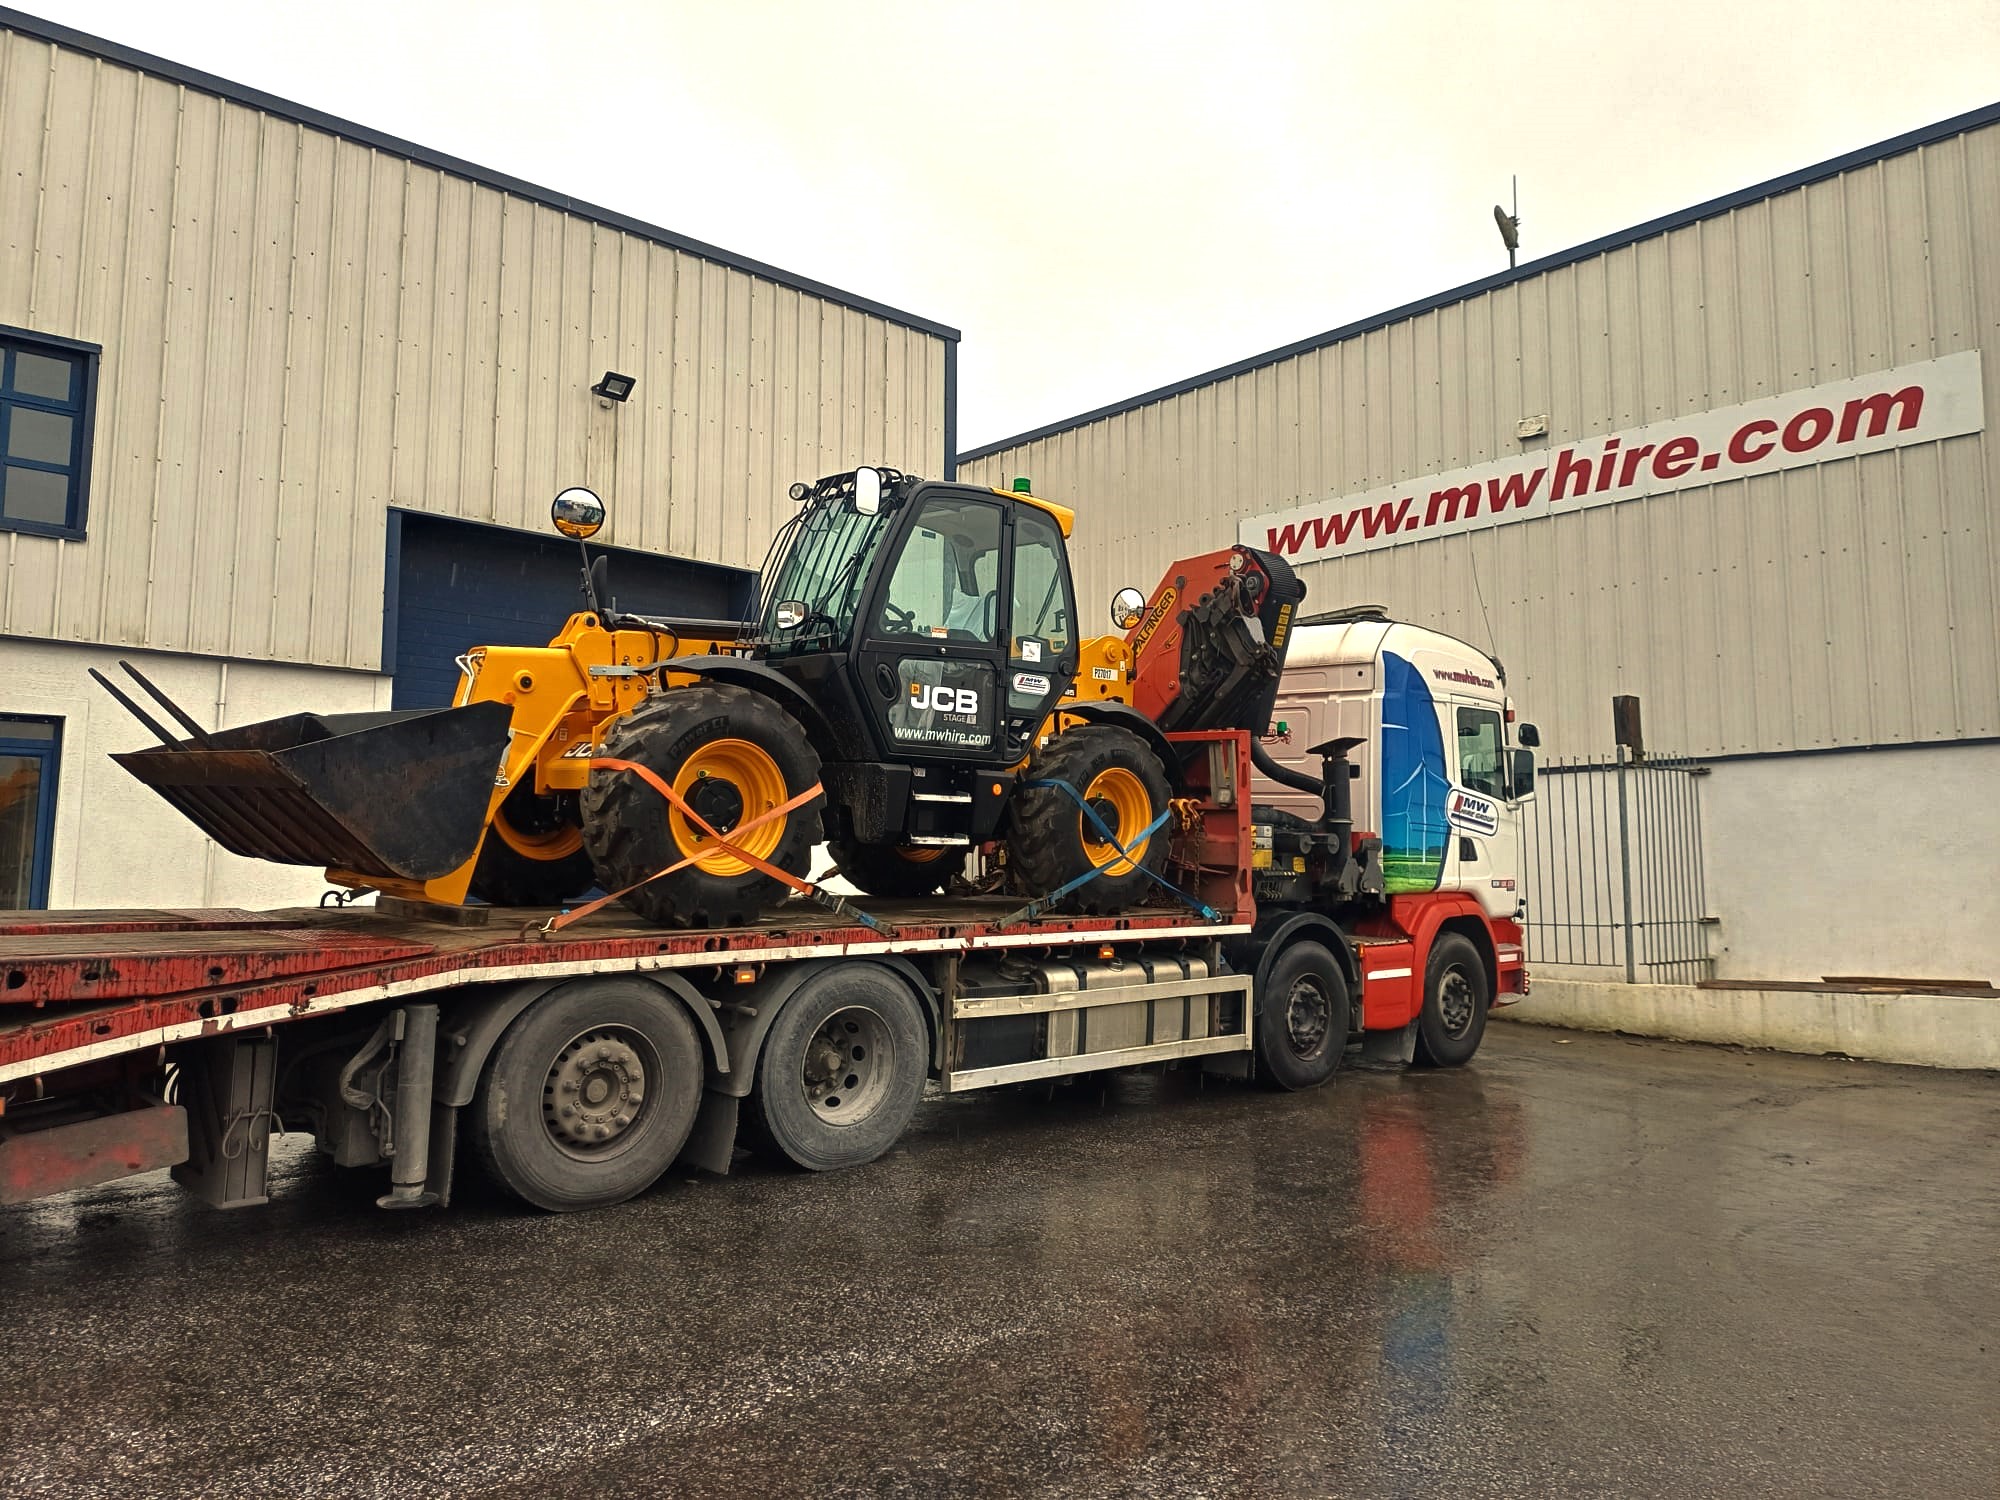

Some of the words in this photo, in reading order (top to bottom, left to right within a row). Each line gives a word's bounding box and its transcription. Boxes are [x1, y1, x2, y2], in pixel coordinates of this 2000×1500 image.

[1267, 385, 1924, 555] www.mwhire.com
[1094, 668, 1112, 679] P27017
[910, 684, 978, 714] JCB
[943, 713, 966, 722] STAGE
[894, 727, 991, 745] www.mwhire.com
[1463, 797, 1489, 813] MW
